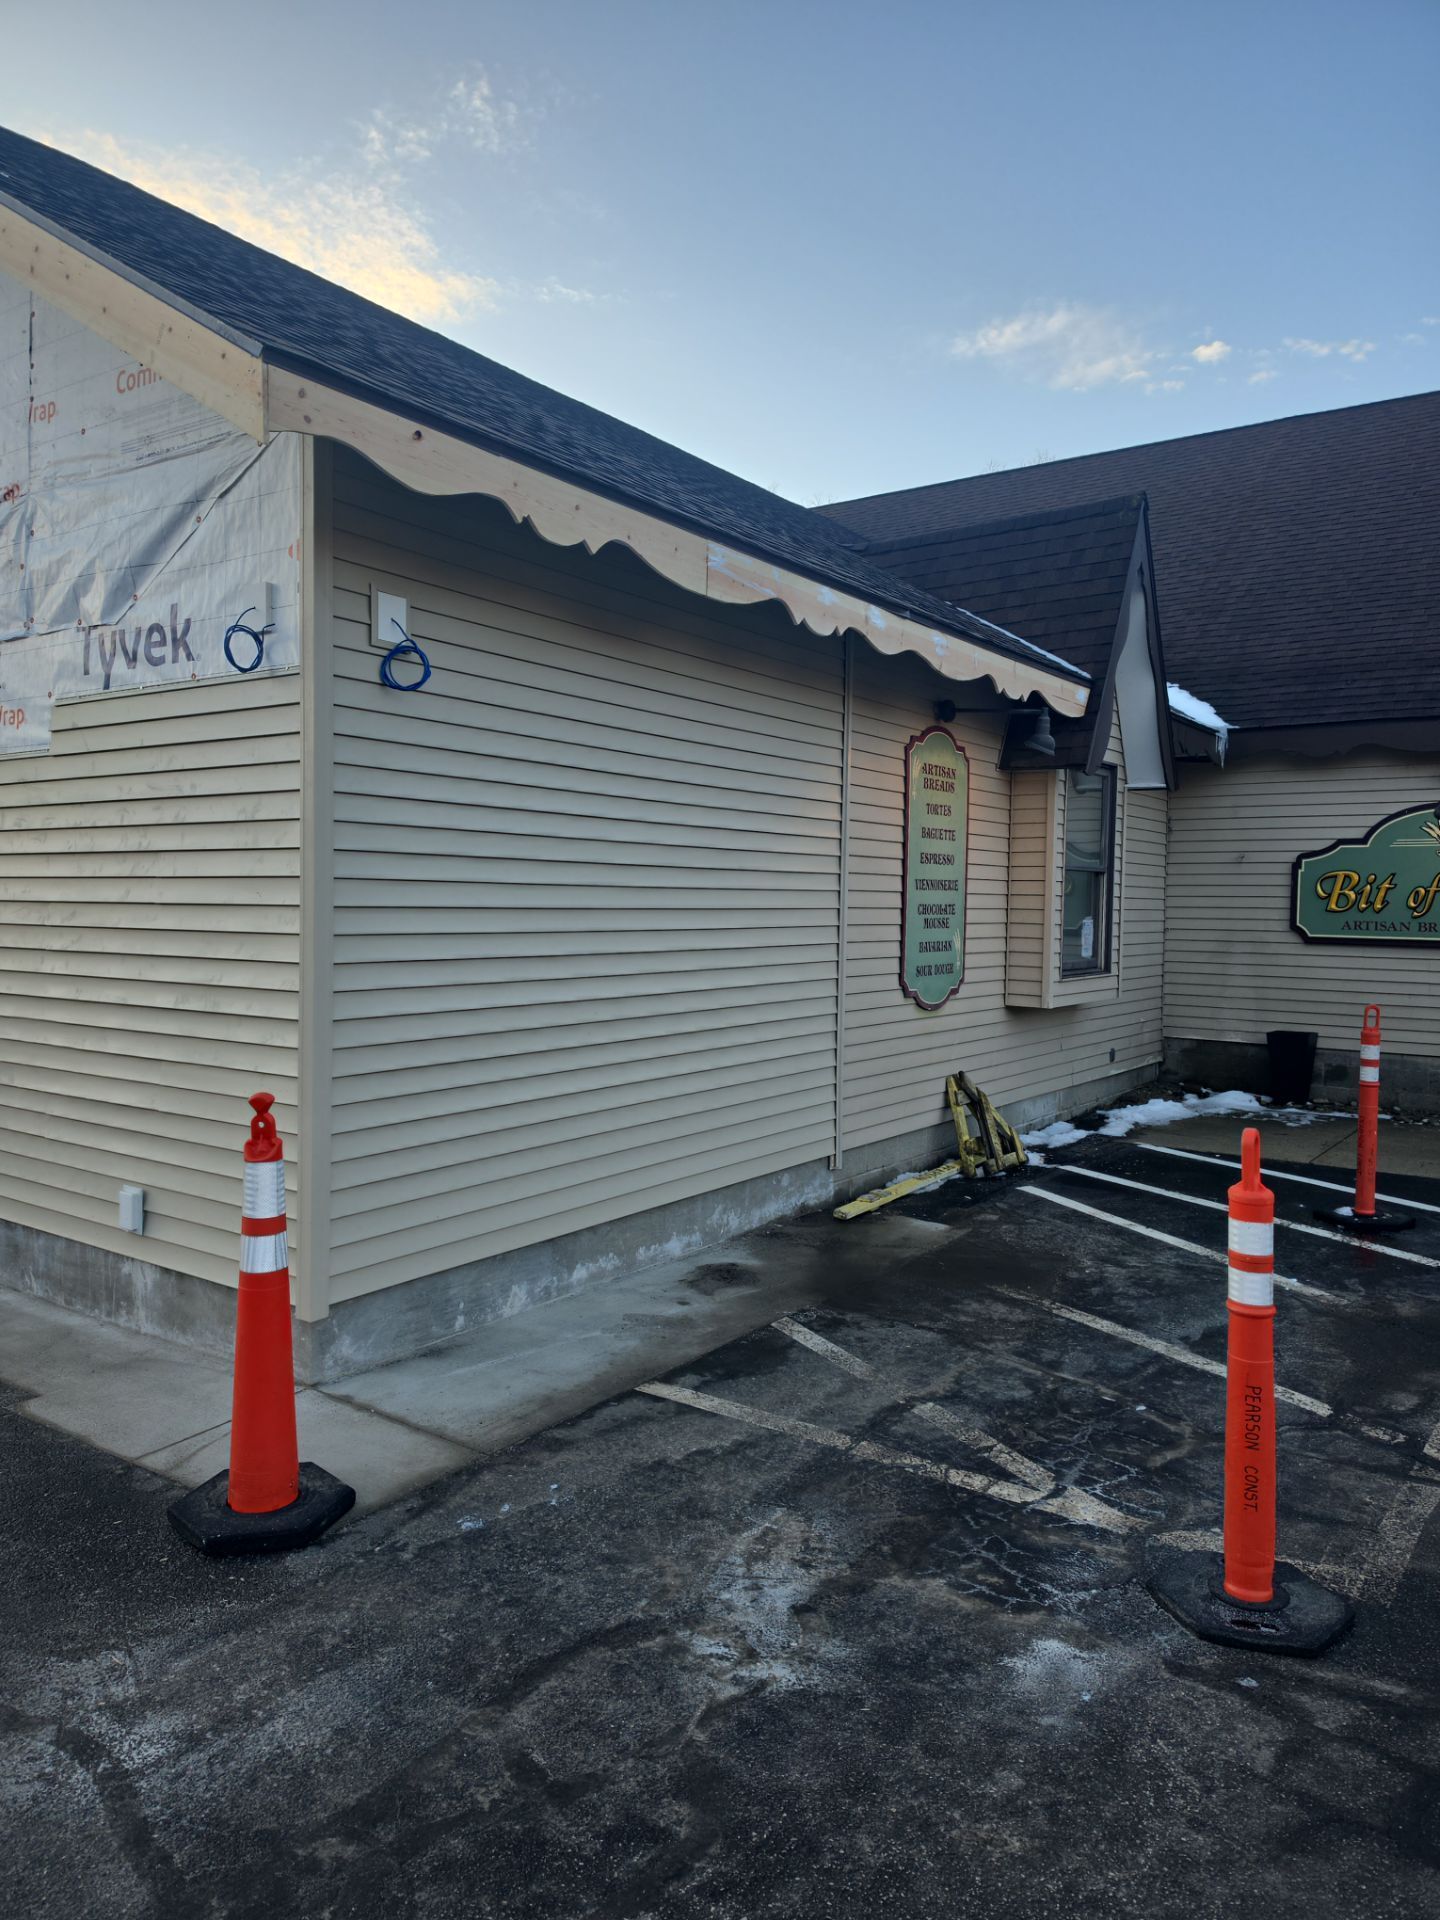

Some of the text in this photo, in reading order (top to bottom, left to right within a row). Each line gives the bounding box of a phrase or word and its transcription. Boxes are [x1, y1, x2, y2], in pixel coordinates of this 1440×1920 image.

[76, 602, 195, 690] Tyvek
[921, 762, 956, 780] ARTISAN
[923, 778, 955, 793] BREADS
[926, 803, 952, 817] TORTES
[921, 827, 956, 841] BAGUETTE
[920, 852, 955, 866] ESPRESSO
[1315, 869, 1440, 919] Bit of
[917, 904, 955, 915] CHOCOLATE
[923, 917, 950, 929] MOUSSE
[1341, 920, 1411, 932] ARTISAN
[919, 941, 952, 953] BAVARIAN
[915, 963, 954, 977] SOUR DOUGH
[1243, 1384, 1262, 1512] PEARSON CONST.
